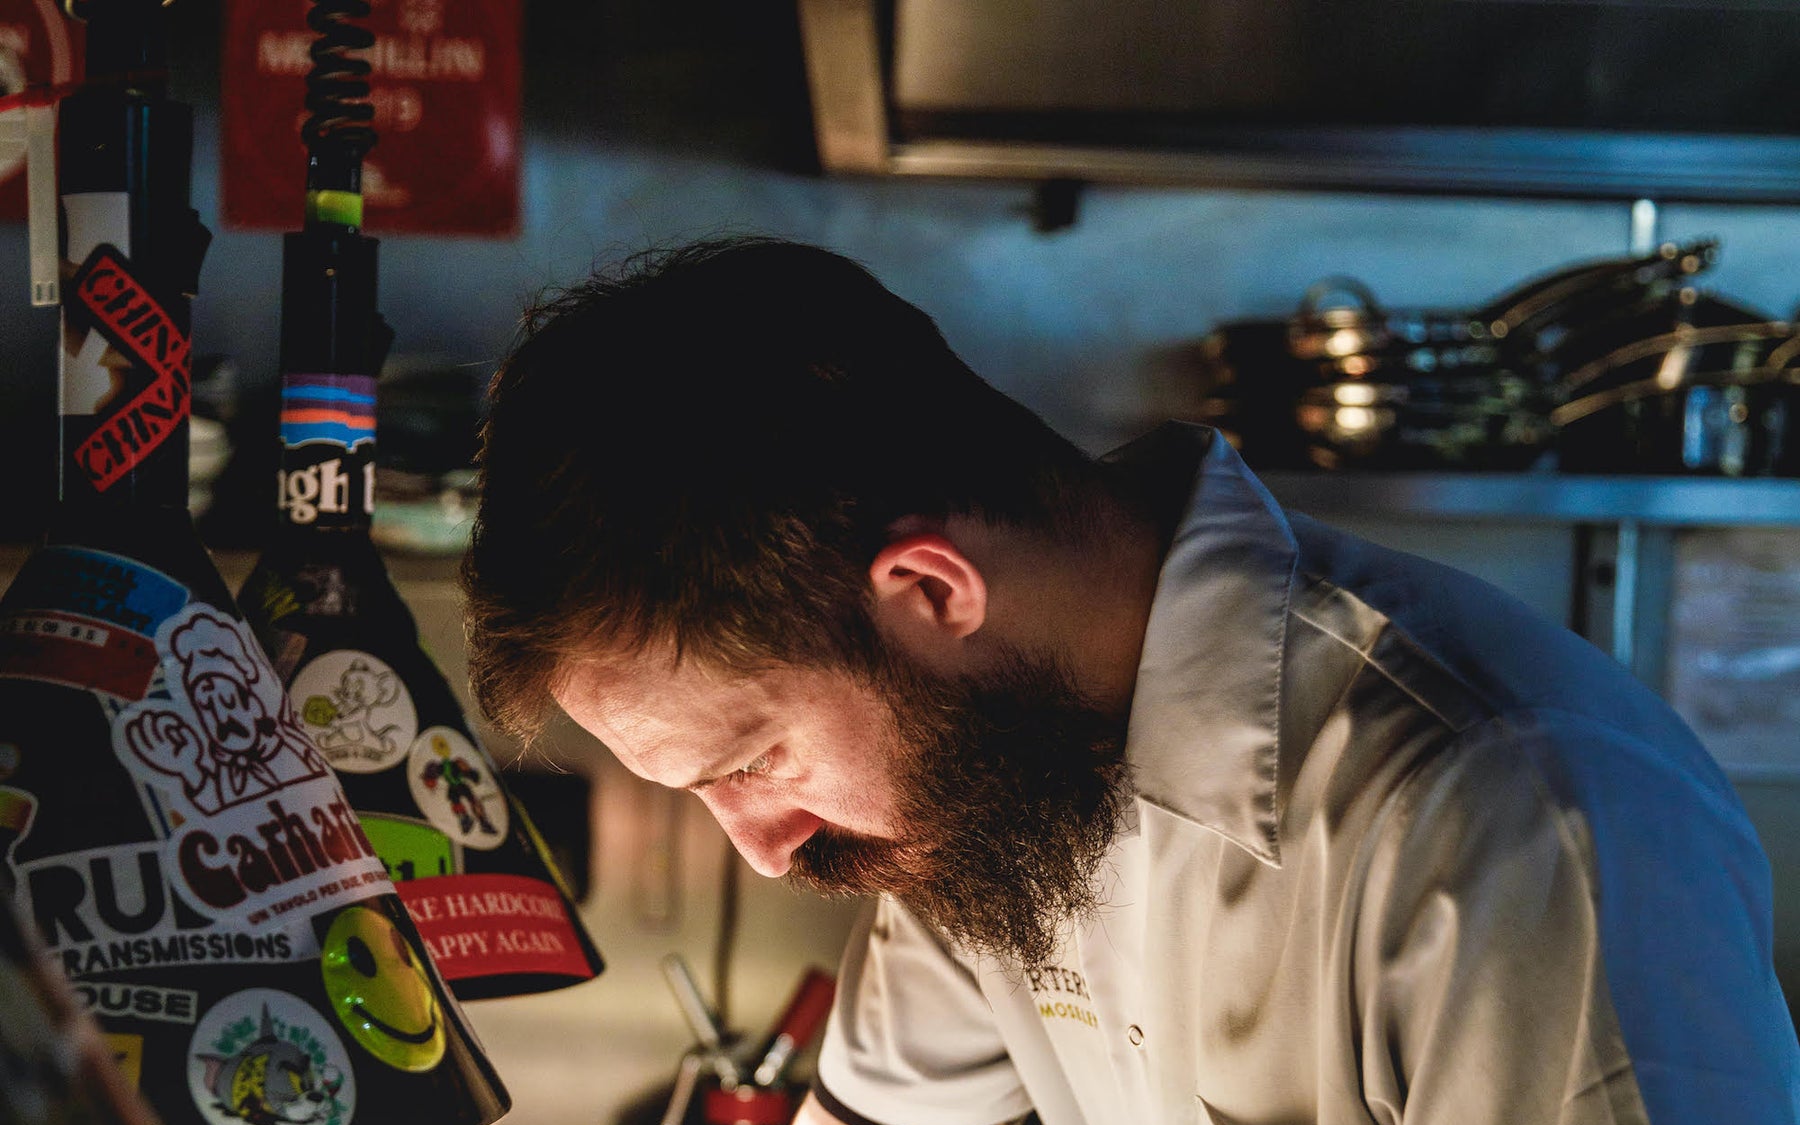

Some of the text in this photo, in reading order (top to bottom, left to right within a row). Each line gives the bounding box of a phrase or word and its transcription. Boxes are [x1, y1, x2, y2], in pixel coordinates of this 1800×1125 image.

[62, 932, 293, 977] RANSMISSIONS
[424, 929, 566, 960] APPY AGAIN
[75, 985, 191, 1018] OUSE
